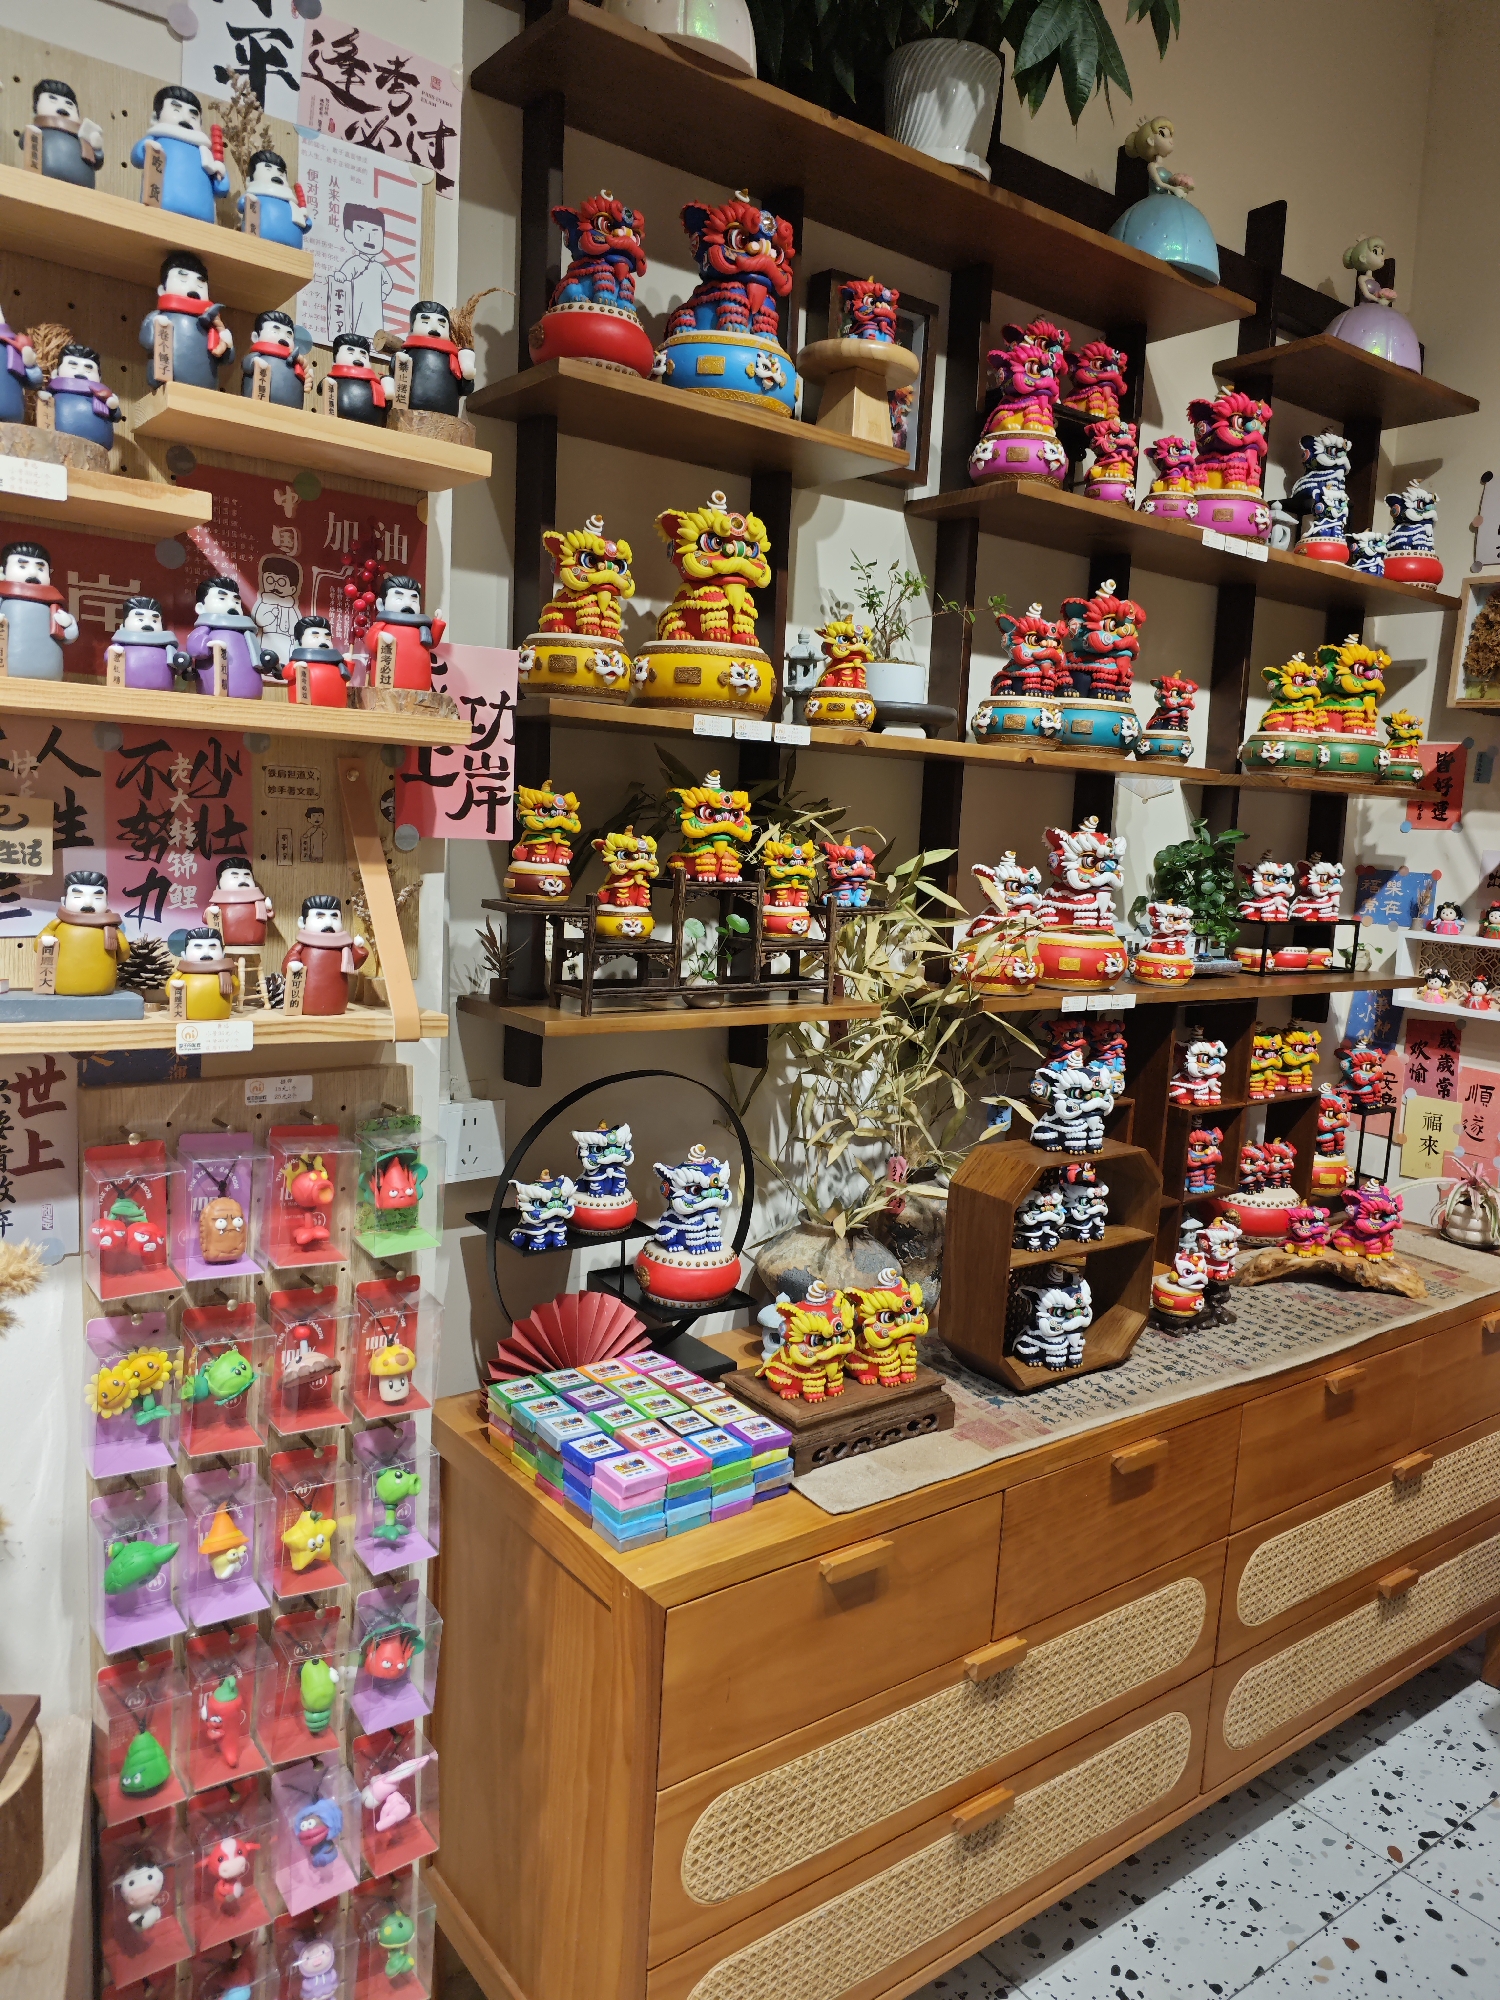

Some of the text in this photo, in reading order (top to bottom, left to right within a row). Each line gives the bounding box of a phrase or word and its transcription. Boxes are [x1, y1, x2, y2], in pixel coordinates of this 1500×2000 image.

[148, 154, 163, 202] 吃货
[271, 486, 299, 557] 中国
[323, 511, 408, 565] 加油
[379, 643, 393, 686] 逢考必过
[37, 725, 102, 850] 人生
[187, 737, 248, 861] 少壮
[116, 739, 177, 932] 不努力
[167, 752, 198, 910] 老大转锦鲤
[289, 971, 303, 1008] 你可以的
[6, 1054, 67, 1176] 世上
[1420, 1112, 1443, 1156] 福來
[1462, 1083, 1496, 1142] 順遂
